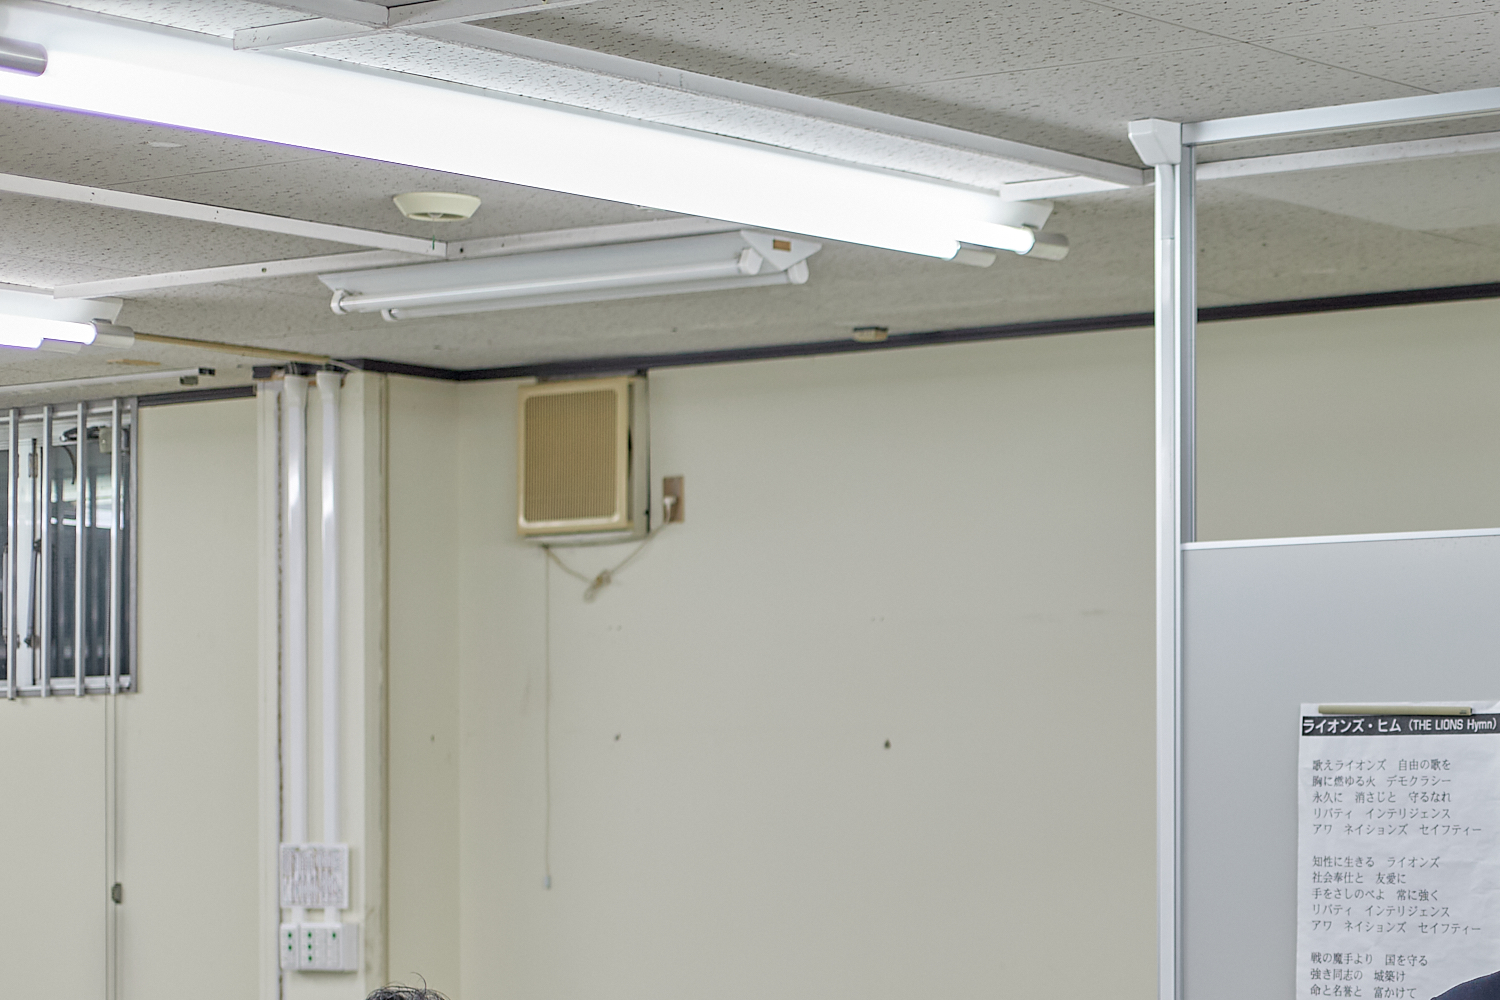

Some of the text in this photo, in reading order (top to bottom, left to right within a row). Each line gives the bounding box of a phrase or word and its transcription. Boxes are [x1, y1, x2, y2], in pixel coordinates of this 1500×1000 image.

[1302, 718, 1402, 734] ライオンズ・ヒム
[1435, 718, 1464, 732] LIONS
[1312, 758, 1451, 772] 歌えライオンズ 自由の歌を
[1311, 774, 1452, 788] 胸に燃ゆる火 デモクラシー
[1312, 790, 1452, 804] 永久に 消さじと 守るなれ
[1313, 807, 1451, 820] リバティ インテリジェンス
[1312, 823, 1482, 837] アワ ネイションズ セイフティー
[1311, 855, 1441, 869] 知性に生きる ライオンズ
[1311, 871, 1407, 885] 社会奉仕と 友愛に
[1311, 887, 1438, 902] 手をさしのべよ 常に強く
[1312, 903, 1450, 918] リバティ インテリジェンス
[1311, 919, 1482, 936] アワ ネイションズ セイフティー
[1310, 951, 1428, 967] 戦の魔手より 国を守る
[1310, 967, 1406, 983] 強き同志の 城築け
[1310, 983, 1363, 998] 命と名誉と
